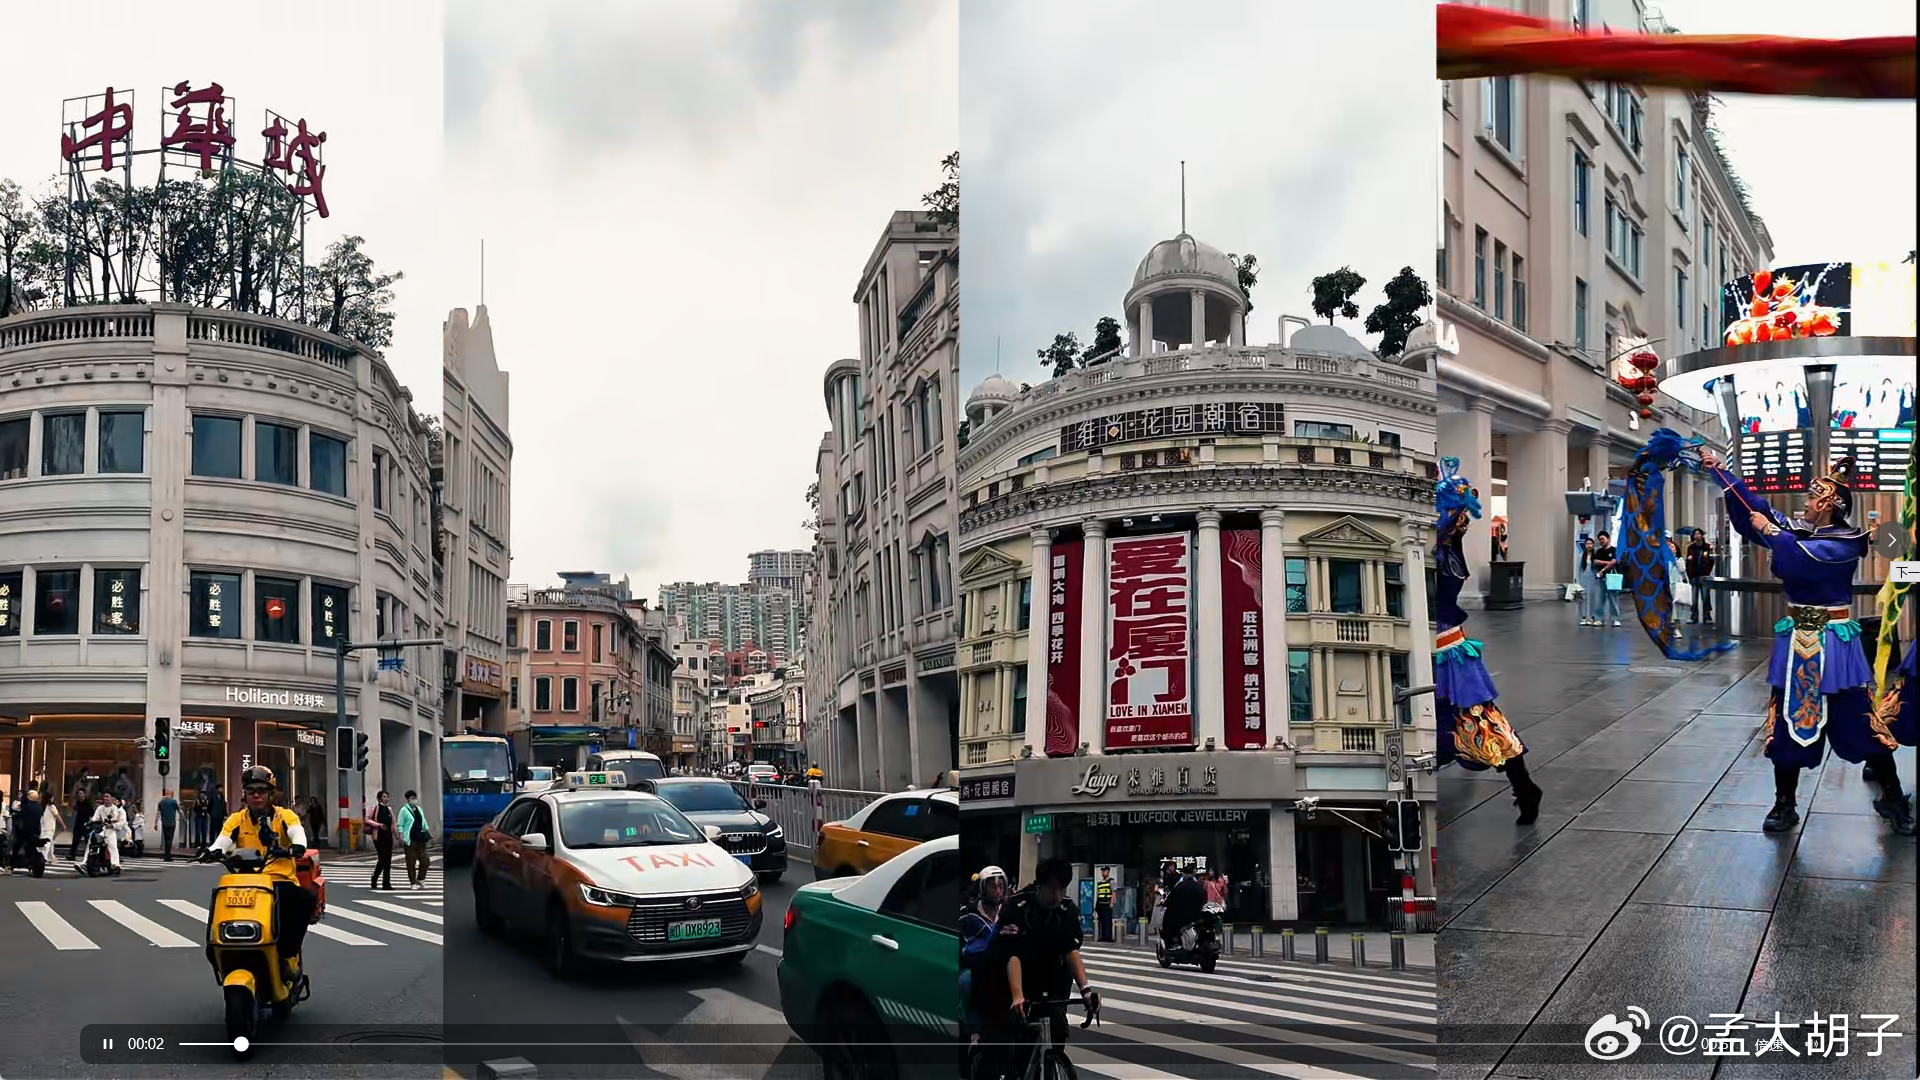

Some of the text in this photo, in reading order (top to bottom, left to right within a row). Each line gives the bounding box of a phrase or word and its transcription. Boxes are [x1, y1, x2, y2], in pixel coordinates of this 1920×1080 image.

[112, 581, 124, 625] 必胜客
[209, 583, 221, 627] 必胜客
[324, 596, 334, 637] 必胜客
[1051, 612, 1064, 663] 四季花开
[1110, 536, 1187, 705] 爱在厦门
[226, 687, 325, 708] Holiland 好利来
[1110, 703, 1188, 717] LOVE IN XIAMEN
[1070, 763, 1119, 797] Laiya
[1128, 811, 1178, 824] LUKFOOK
[1181, 810, 1248, 822] JEWELLERY
[617, 852, 716, 872] TAXI
[686, 922, 720, 937] DX8923
